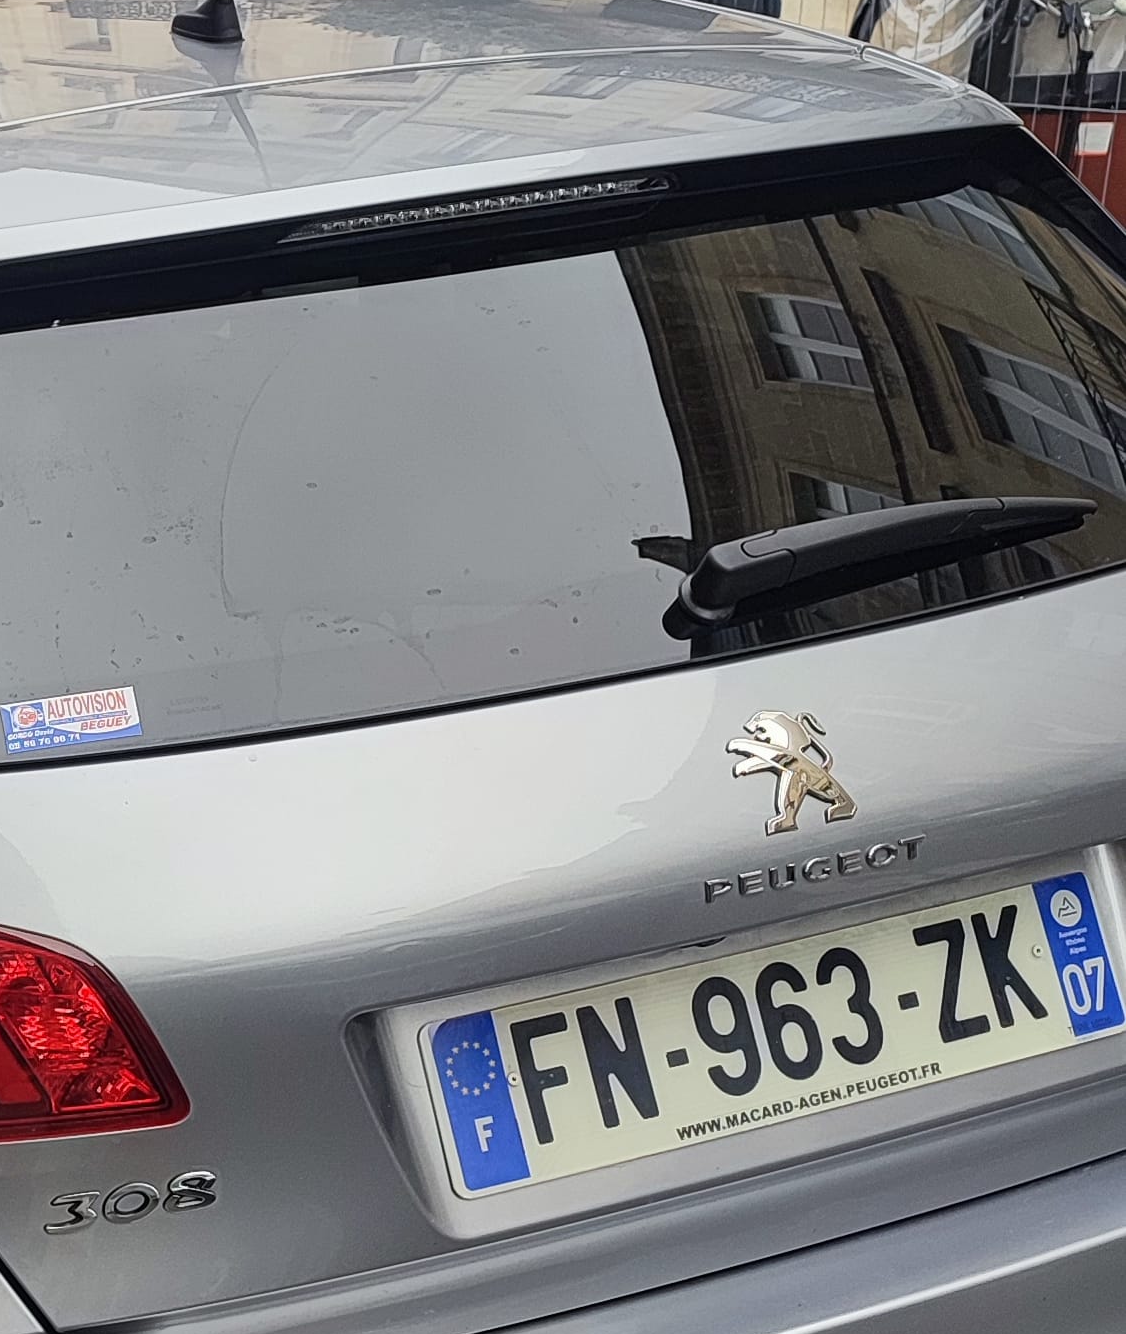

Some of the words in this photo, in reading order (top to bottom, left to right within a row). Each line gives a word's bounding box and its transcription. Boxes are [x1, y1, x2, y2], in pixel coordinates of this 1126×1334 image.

[47, 690, 127, 719] AUTOVISION
[80, 715, 132, 731] BEGUEY
[705, 833, 927, 904] PEUGEOT
[1062, 956, 1105, 1016] 07
[510, 905, 1048, 1145] FN-963-ZK
[676, 1062, 942, 1141] WWW.MACARD-AGEN.PEUGEOT.FR
[474, 1115, 495, 1153] F
[43, 1171, 217, 1235] 308
